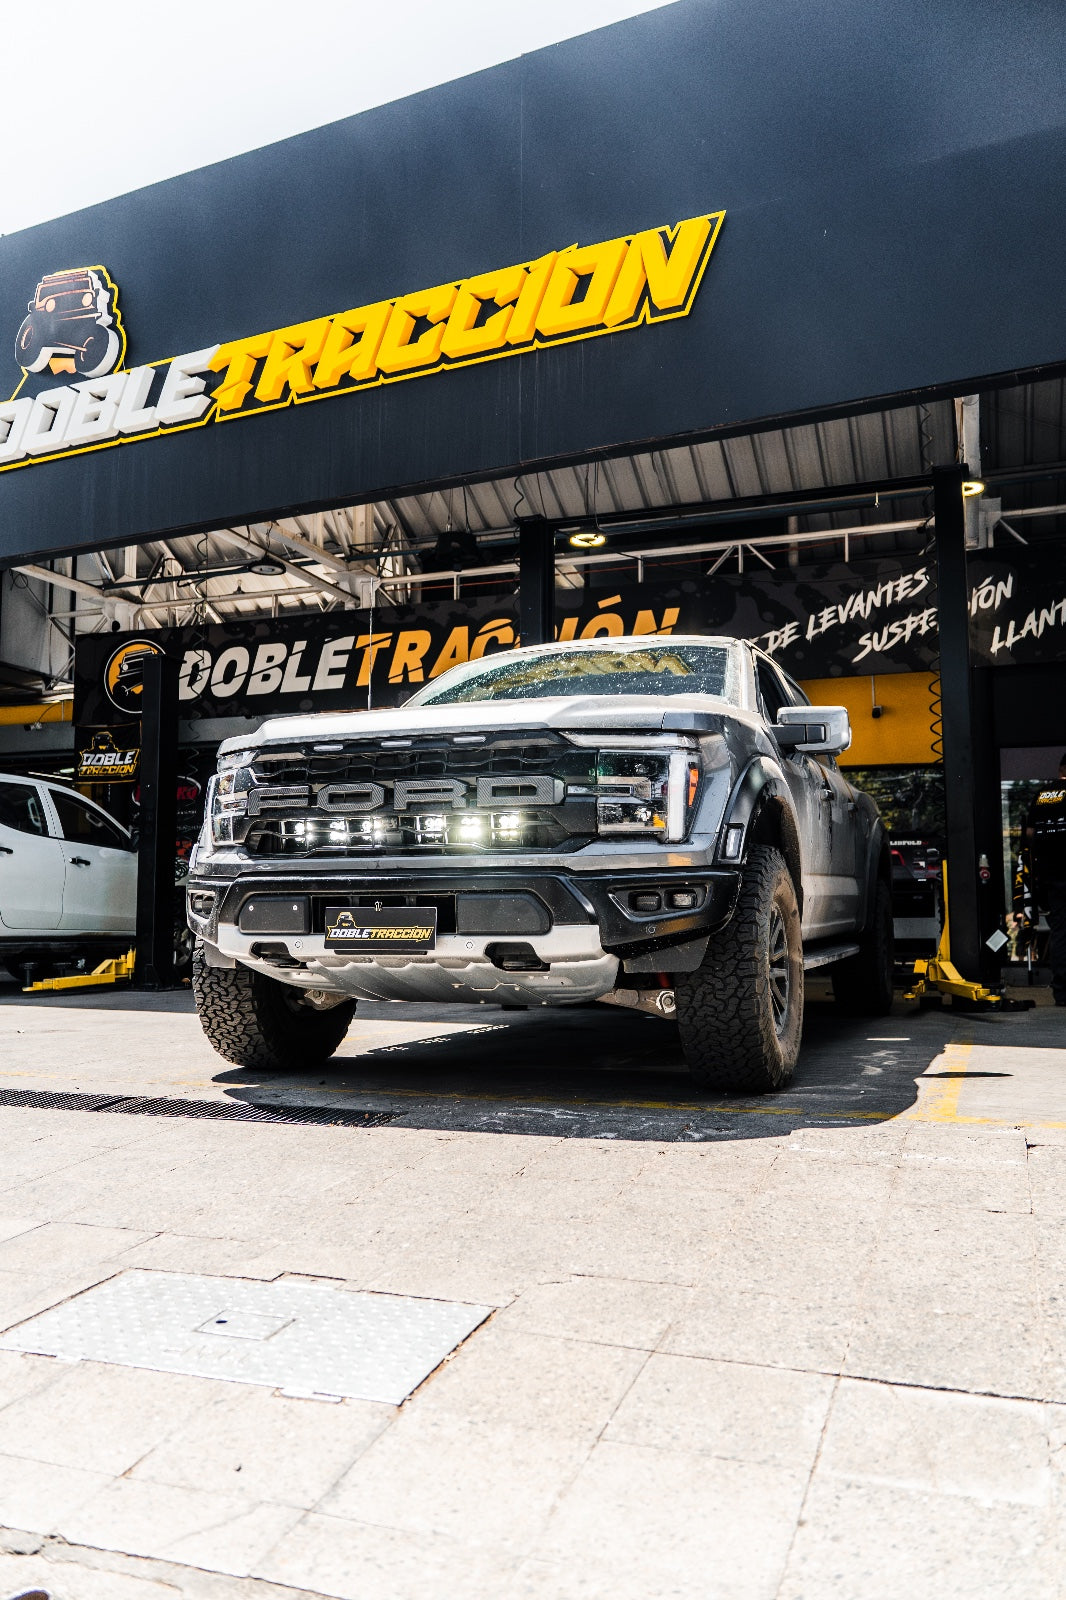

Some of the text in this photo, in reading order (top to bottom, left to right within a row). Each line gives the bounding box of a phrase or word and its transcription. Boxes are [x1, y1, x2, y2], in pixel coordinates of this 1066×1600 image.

[761, 567, 931, 656] DE LEVANTES
[852, 572, 1014, 663] SUSPEIÓN
[82, 751, 136, 766] DOBLE
[248, 775, 558, 816] FORD
